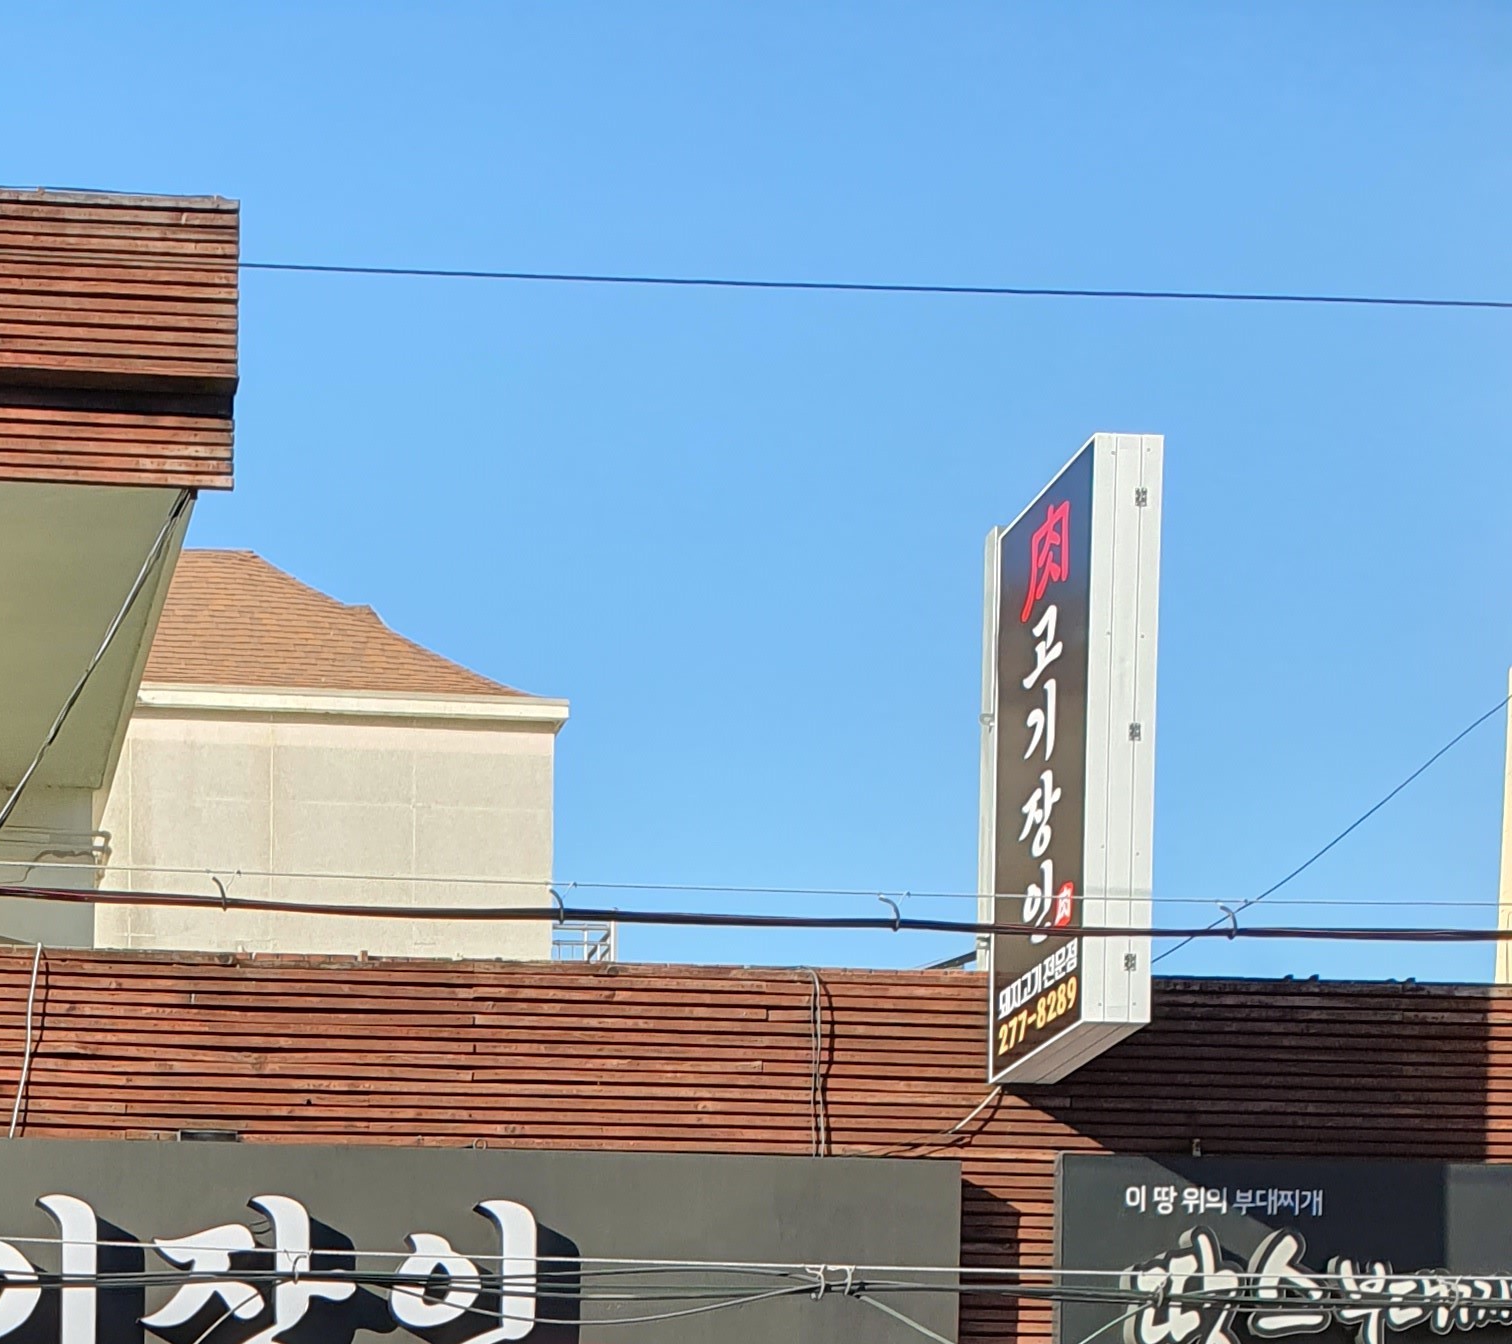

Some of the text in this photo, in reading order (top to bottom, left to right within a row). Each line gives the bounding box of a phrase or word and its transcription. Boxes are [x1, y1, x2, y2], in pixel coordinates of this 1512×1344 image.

[1018, 603, 1062, 944] 고기장인
[1043, 936, 1078, 989] 전문점
[997, 976, 1077, 1056] 277-8289
[1125, 1186, 1324, 1217] 이 땅 위의 부대찌개
